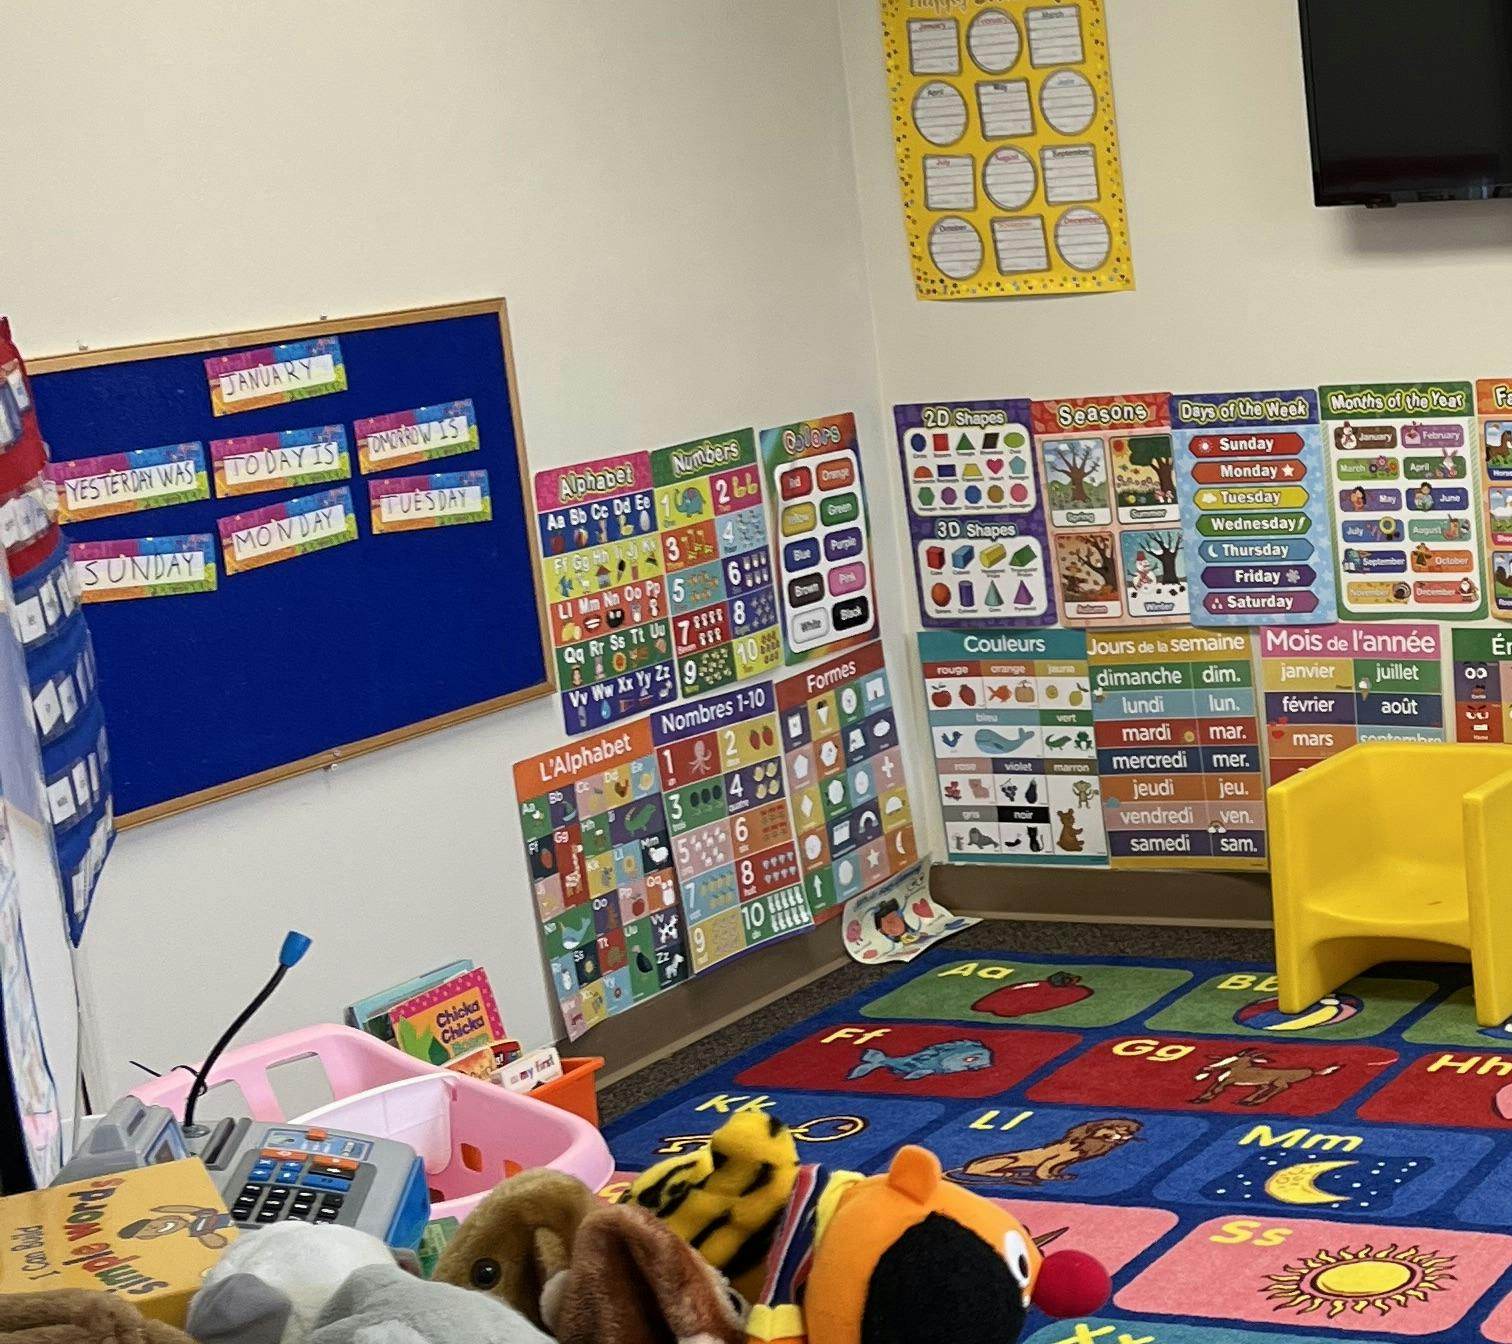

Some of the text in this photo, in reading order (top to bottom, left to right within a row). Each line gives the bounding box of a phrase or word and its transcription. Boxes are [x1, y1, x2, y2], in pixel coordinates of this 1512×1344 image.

[220, 359, 314, 397] JANUARY
[1332, 391, 1463, 410] Months of the Year
[923, 409, 1005, 429] 2D Shapes
[1059, 404, 1147, 427] Seasons
[1181, 399, 1307, 423] Days of the Week
[438, 418, 460, 440] IS
[783, 424, 841, 454] Colors
[1358, 431, 1392, 443] January
[1423, 428, 1460, 442] February
[1219, 438, 1274, 453] Sunday
[224, 442, 336, 477] TODAY IS
[672, 440, 740, 476] Numbers
[1410, 462, 1429, 474] April
[67, 460, 194, 503] YESTERDAY WAS
[821, 467, 850, 483] Orange
[1220, 464, 1278, 480] Monday
[560, 463, 634, 502] Alphabet
[382, 488, 468, 516] TUESDAY
[1221, 490, 1281, 506] Tuesday
[1380, 493, 1397, 505] May
[1440, 493, 1461, 504] June
[234, 508, 334, 552] MONDAY
[936, 520, 1016, 540] 3D Shapes
[1211, 517, 1296, 532] Wednesday
[1222, 543, 1289, 558] Thursday
[1435, 555, 1468, 566] October
[83, 552, 196, 587] SUNDAY
[1363, 557, 1405, 568] September
[1235, 569, 1281, 584] Friday
[1227, 595, 1294, 611] Saturday
[963, 635, 1046, 654] Couleurs
[1086, 633, 1245, 656] Jours de la semaine
[1266, 629, 1436, 654] Mois de l'année
[807, 661, 857, 693] Formes
[936, 664, 1026, 676] rouge orange
[1097, 665, 1241, 687] dimanche dim.
[1280, 662, 1420, 683] janvier juillet
[662, 687, 766, 734] Nombres 1-10
[1122, 694, 1240, 714] lundi lun.
[1282, 696, 1419, 715] février août
[1056, 714, 1077, 723] vert
[1122, 724, 1247, 742] mardi mar.
[1292, 733, 1334, 746] mars
[539, 732, 633, 783] L'Alphabet
[1004, 761, 1090, 772] violet marron
[1112, 750, 1250, 770] mercredi mer.
[1132, 778, 1249, 799] jeudi jeu.
[1013, 809, 1034, 820] noir
[1120, 806, 1254, 824] vendredi ven.
[1130, 834, 1258, 853] samedi sam.
[937, 962, 1014, 980] Aa
[435, 999, 481, 1030] Chicka
[440, 1015, 485, 1046] Chicka
[820, 1028, 892, 1045] Ff
[1112, 1039, 1196, 1061] Gg
[519, 1054, 554, 1081] my first
[968, 1110, 1034, 1130] Ll
[1238, 1125, 1364, 1152] Mm
[62, 1177, 170, 1296] simple words
[1209, 1220, 1294, 1247] Ss
[10, 1224, 60, 1280] I Can Build
